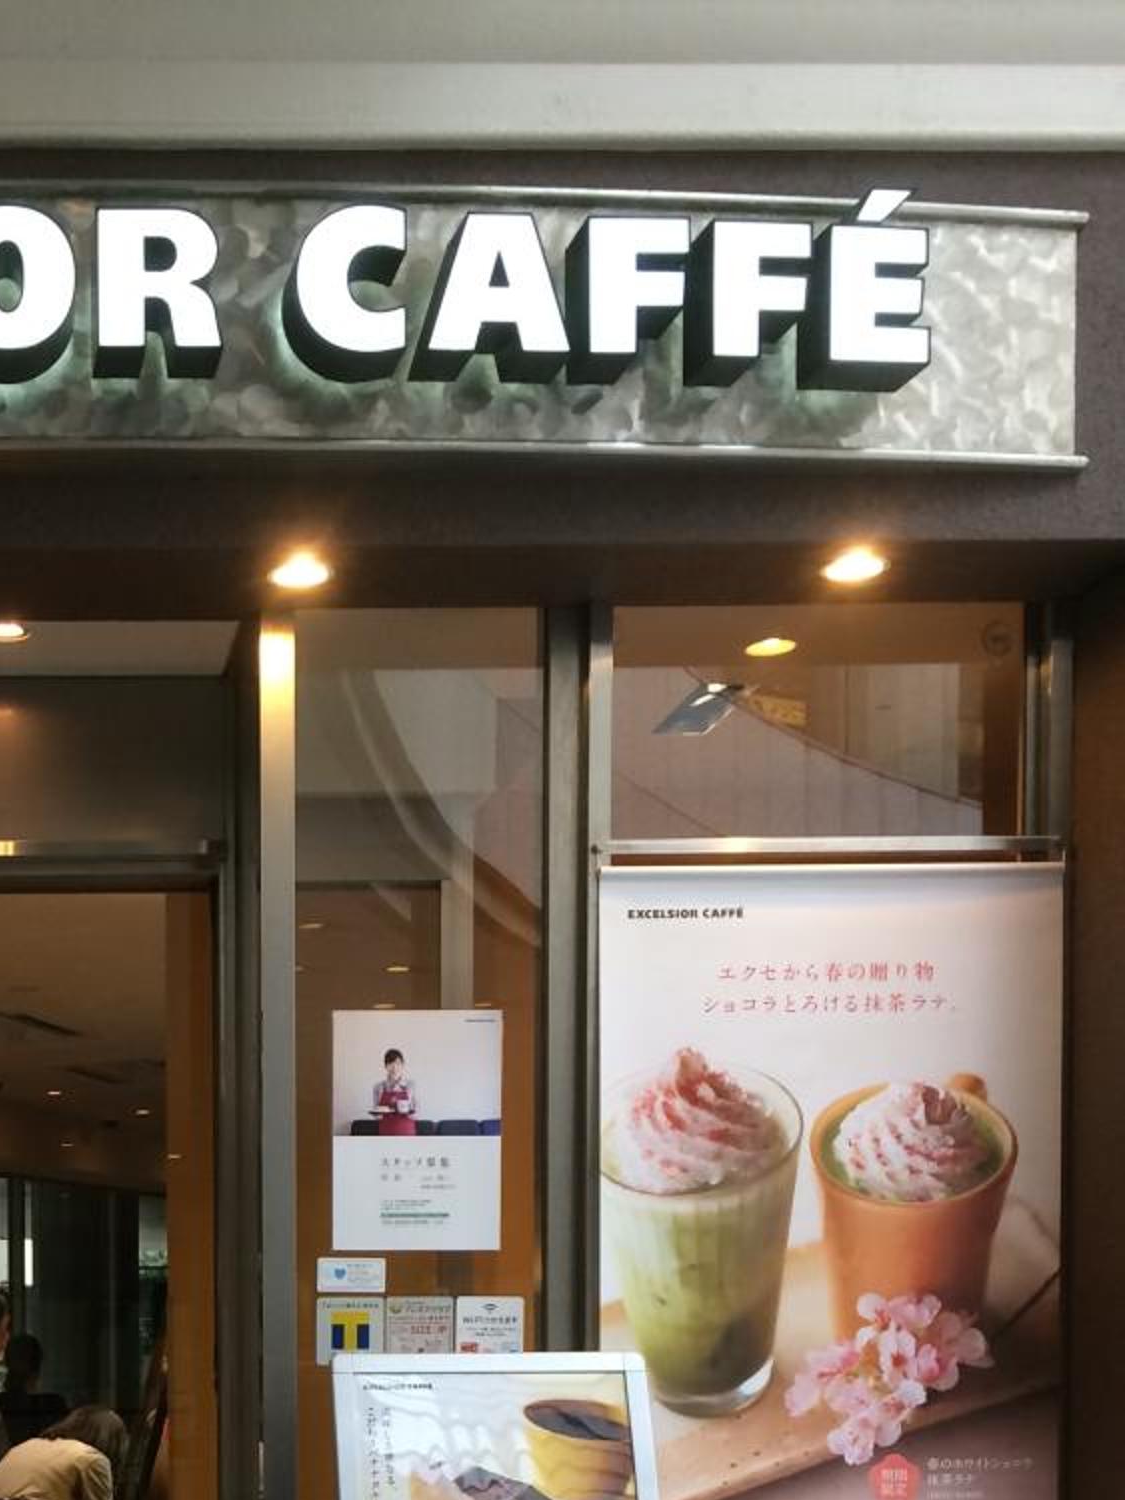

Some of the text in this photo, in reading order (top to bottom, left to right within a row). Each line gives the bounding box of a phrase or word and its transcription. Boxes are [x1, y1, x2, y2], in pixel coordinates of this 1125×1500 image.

[295, 190, 932, 364] CAFFÉ
[627, 906, 744, 919] EXCELSIOR CAFFÉ
[717, 961, 936, 982] エクセから春の贈り物
